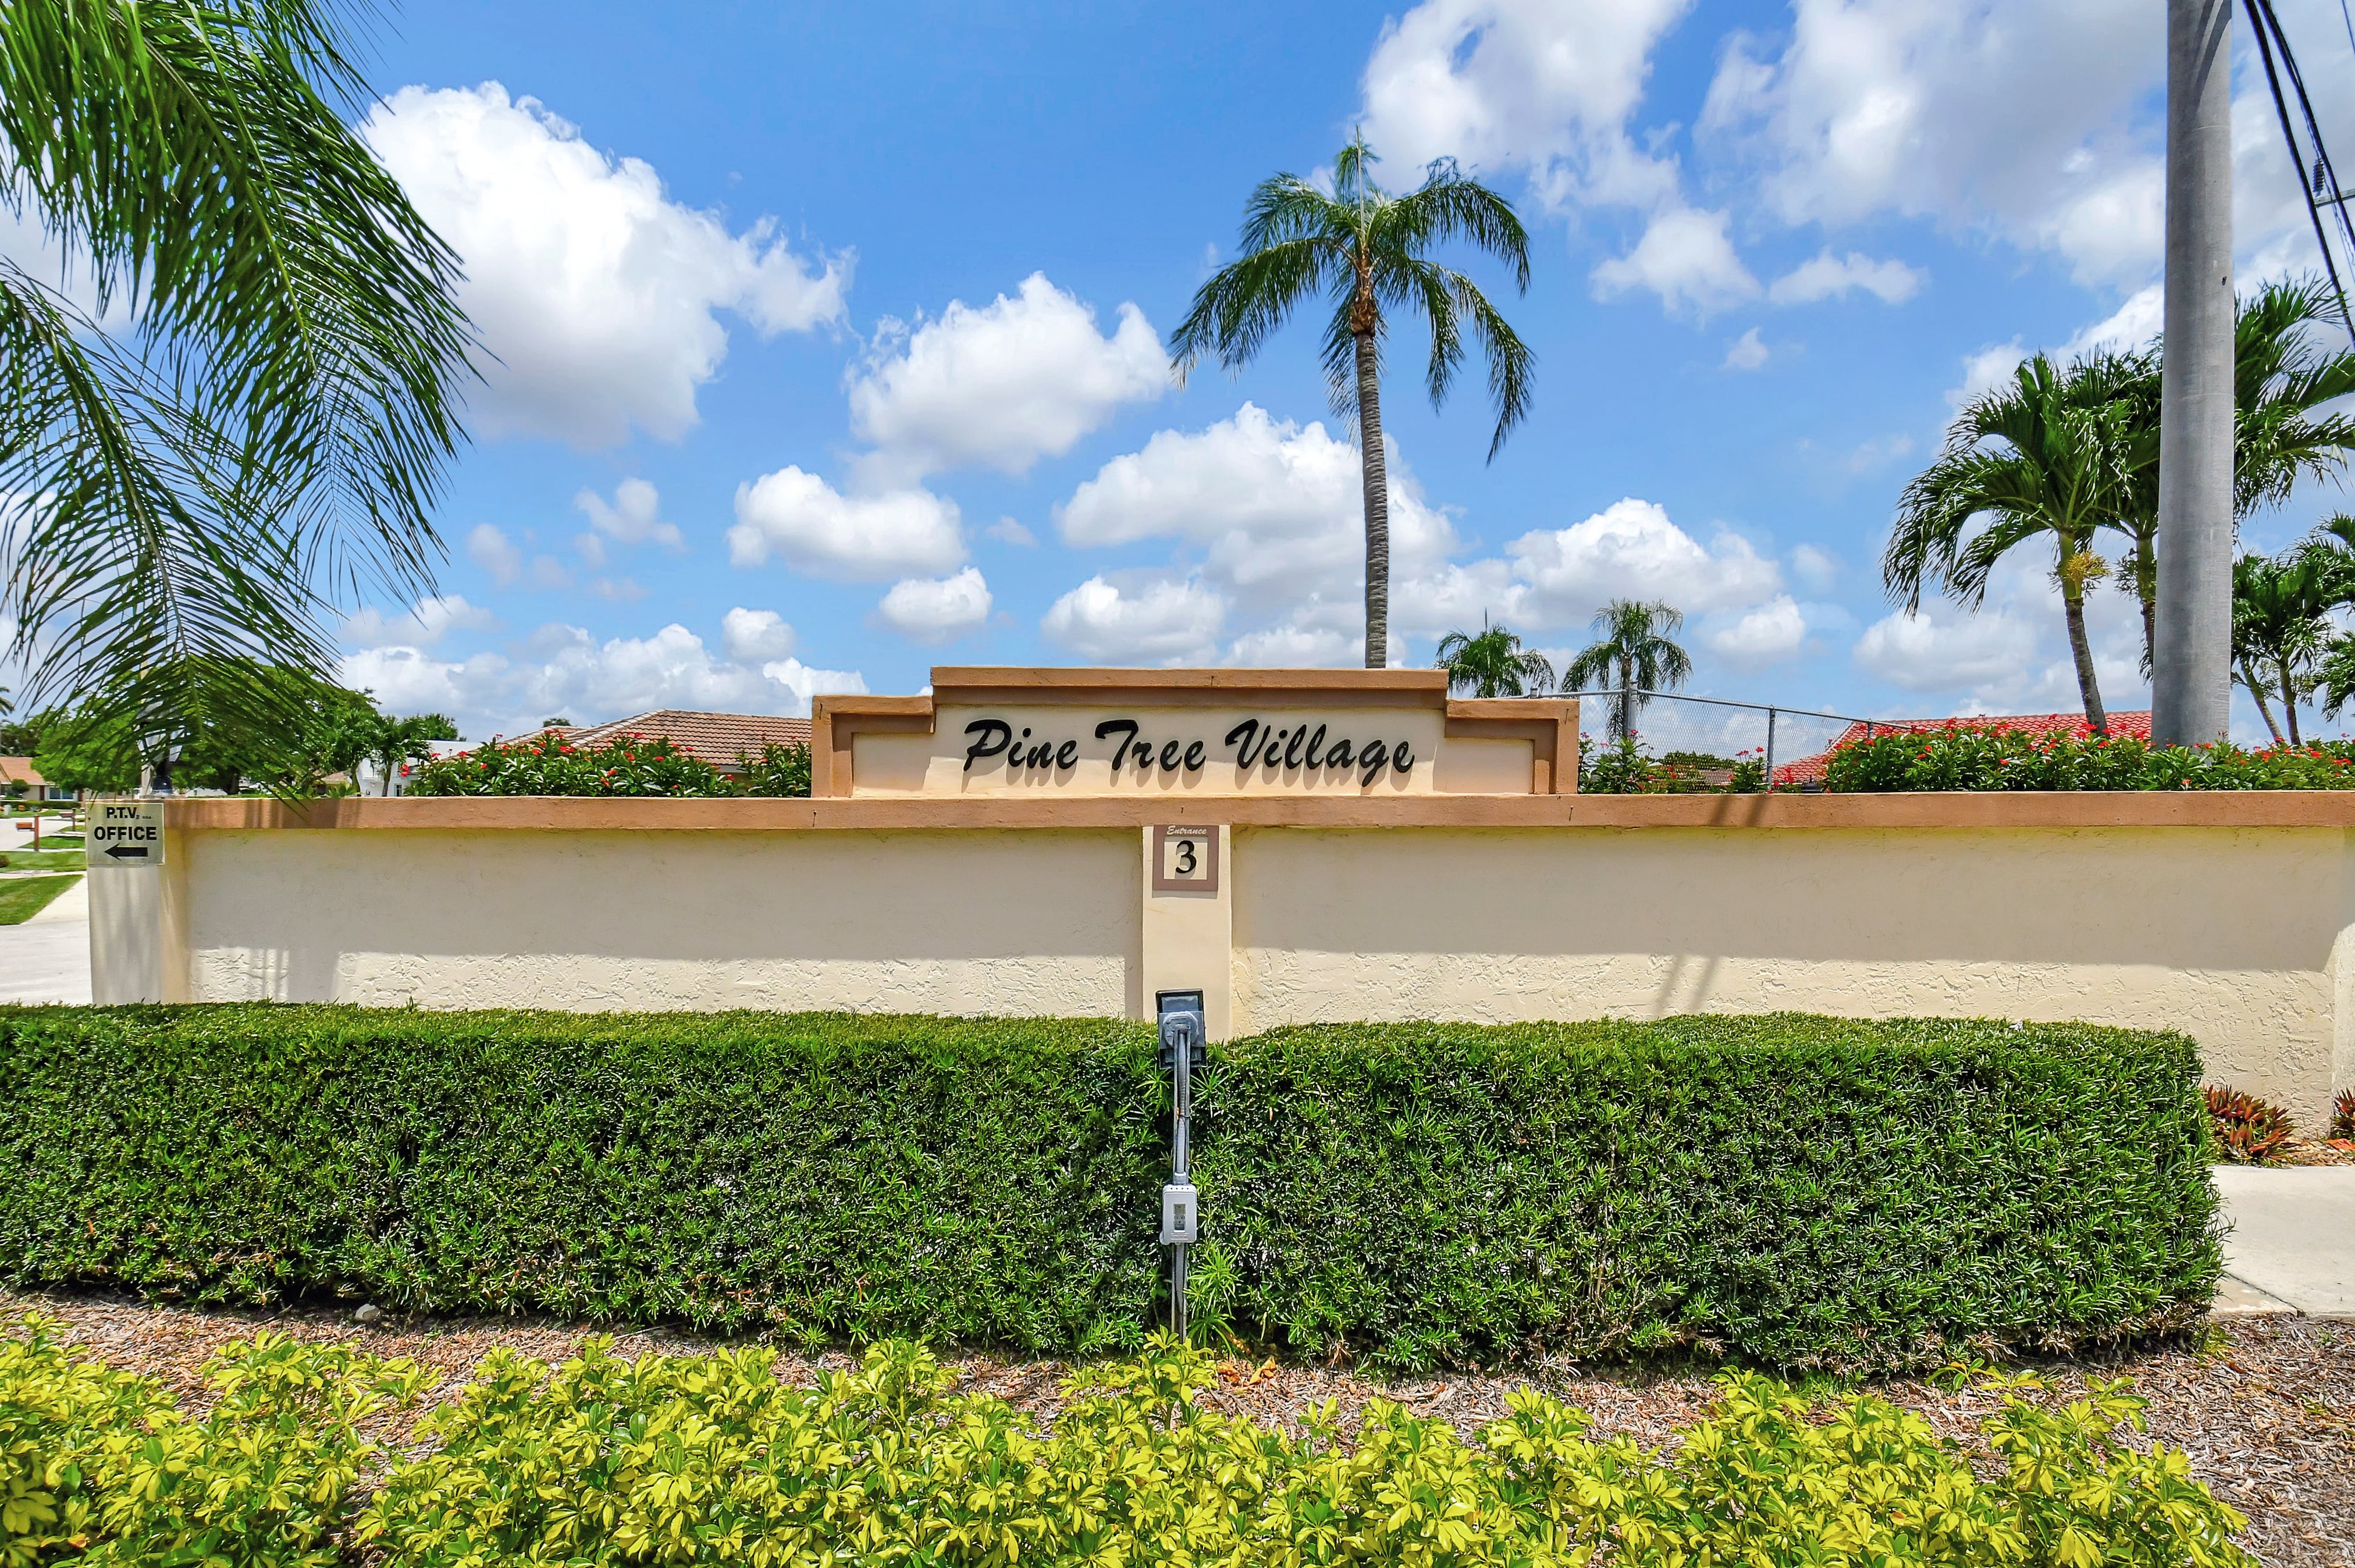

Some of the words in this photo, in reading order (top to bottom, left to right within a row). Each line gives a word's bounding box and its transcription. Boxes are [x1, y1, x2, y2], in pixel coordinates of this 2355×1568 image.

[963, 718, 1079, 772] Pine
[1094, 718, 1207, 772] Tree
[1224, 718, 1415, 788] Village
[94, 826, 157, 840] OFFICE
[1166, 825, 1207, 835] Entrance
[1175, 840, 1197, 874] 3
